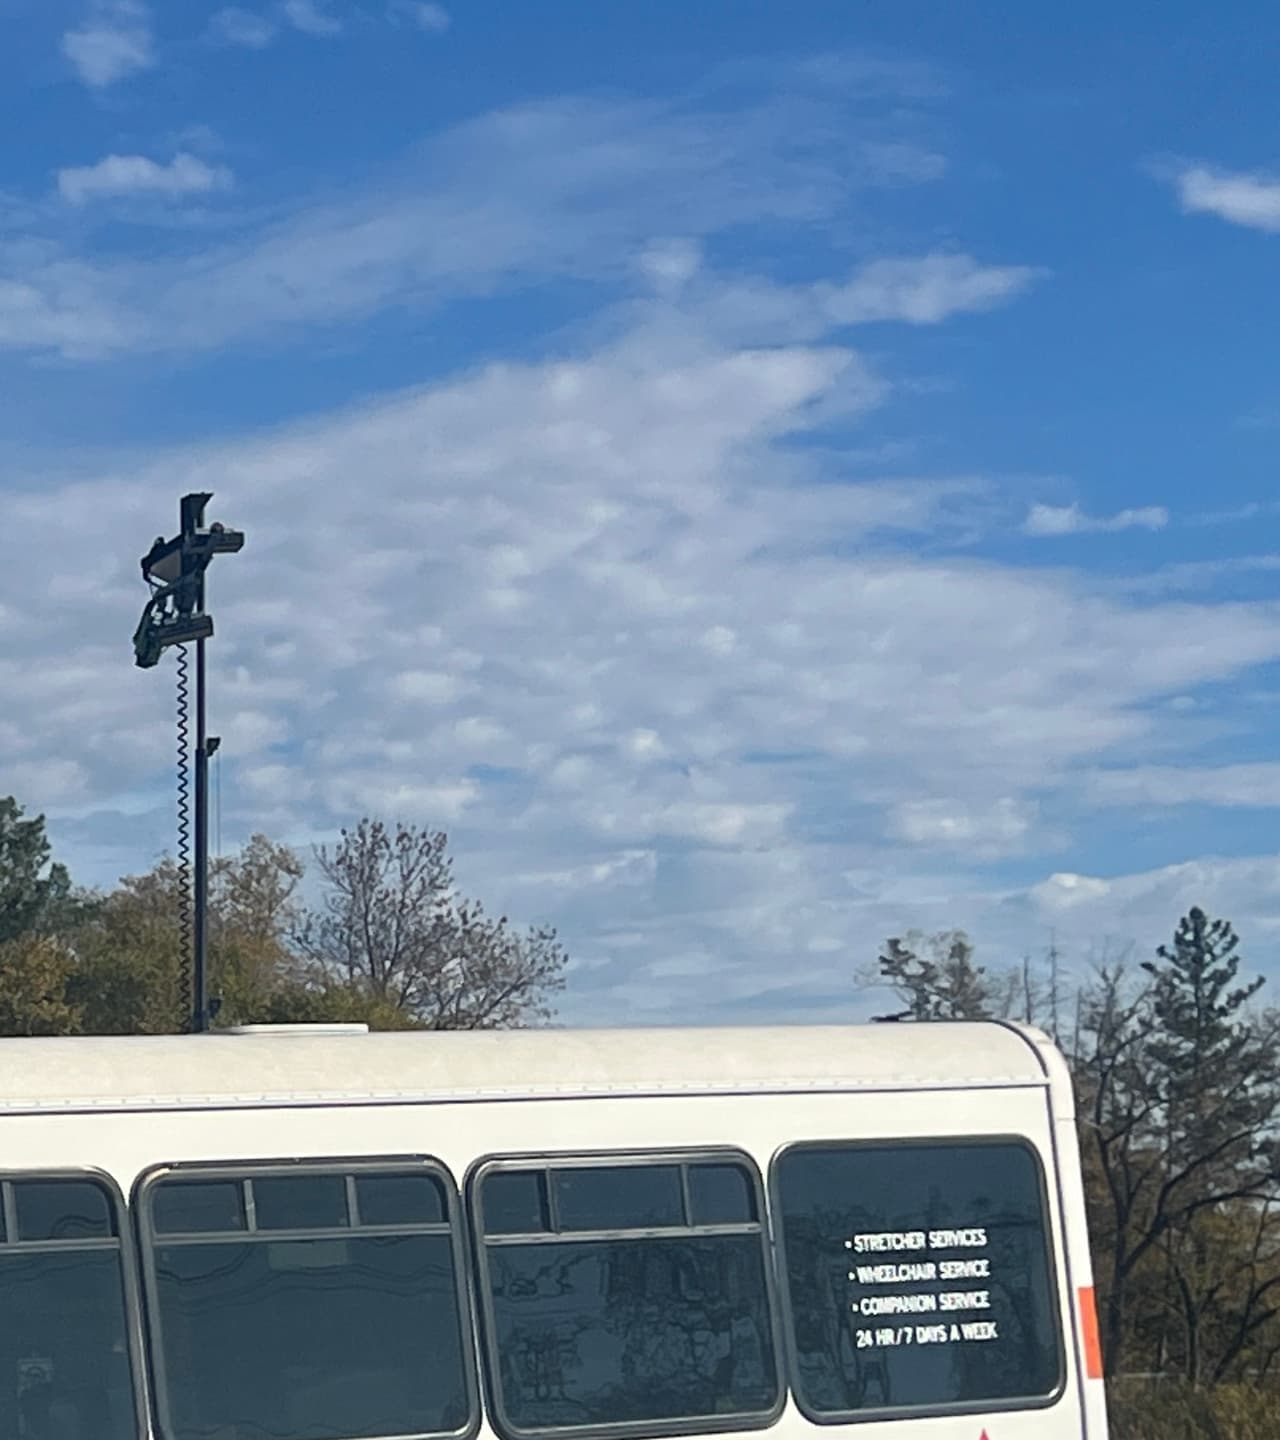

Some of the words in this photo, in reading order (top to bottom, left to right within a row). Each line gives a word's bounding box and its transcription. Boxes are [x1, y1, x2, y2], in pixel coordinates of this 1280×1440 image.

[854, 1231, 926, 1252] STRETCHER
[928, 1228, 988, 1248] SERVICES
[856, 1263, 937, 1283] WHEELCHAIR
[939, 1259, 991, 1280] SERVICE
[860, 1295, 937, 1316] COMPANION
[939, 1290, 991, 1312] SERVICE
[855, 1330, 874, 1349] 24
[915, 1324, 948, 1344] DAYS
[950, 1324, 961, 1341] A
[961, 1321, 999, 1340] WEEK
